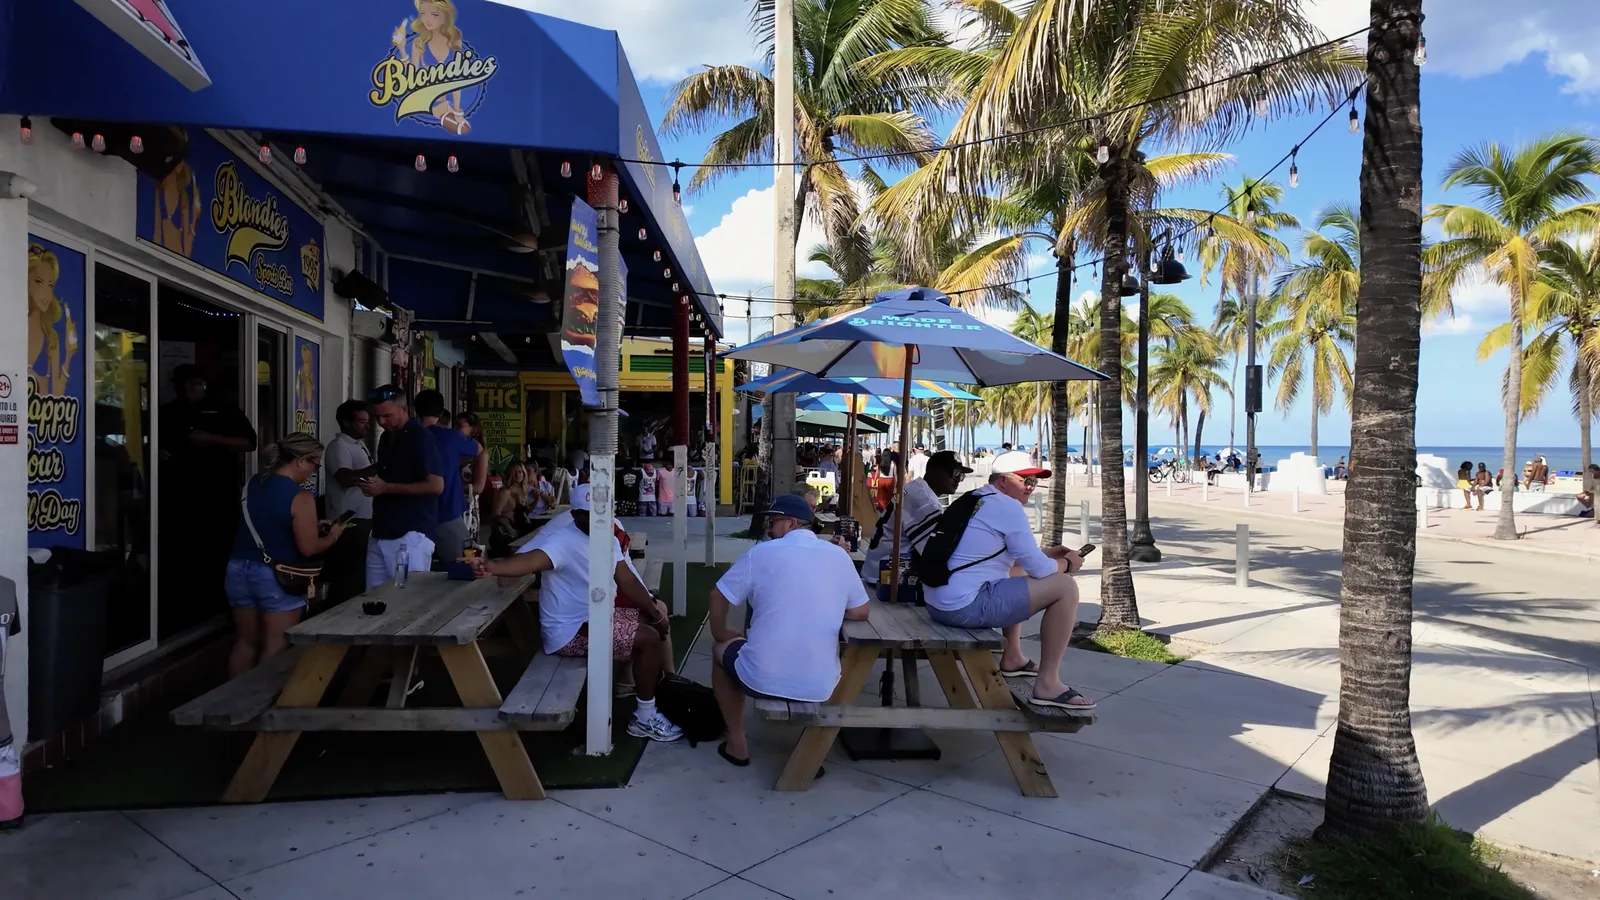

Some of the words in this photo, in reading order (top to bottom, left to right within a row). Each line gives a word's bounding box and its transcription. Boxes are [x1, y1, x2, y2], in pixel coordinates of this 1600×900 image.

[369, 50, 497, 104] Blondies
[211, 161, 289, 241] Blondies
[256, 253, 279, 289] Sports
[279, 266, 293, 295] Bar
[303, 255, 318, 281] 1995
[848, 317, 983, 331] BRIGHTER
[882, 315, 952, 324] MADE
[475, 389, 517, 409] THC
[39, 490, 80, 535] Day
